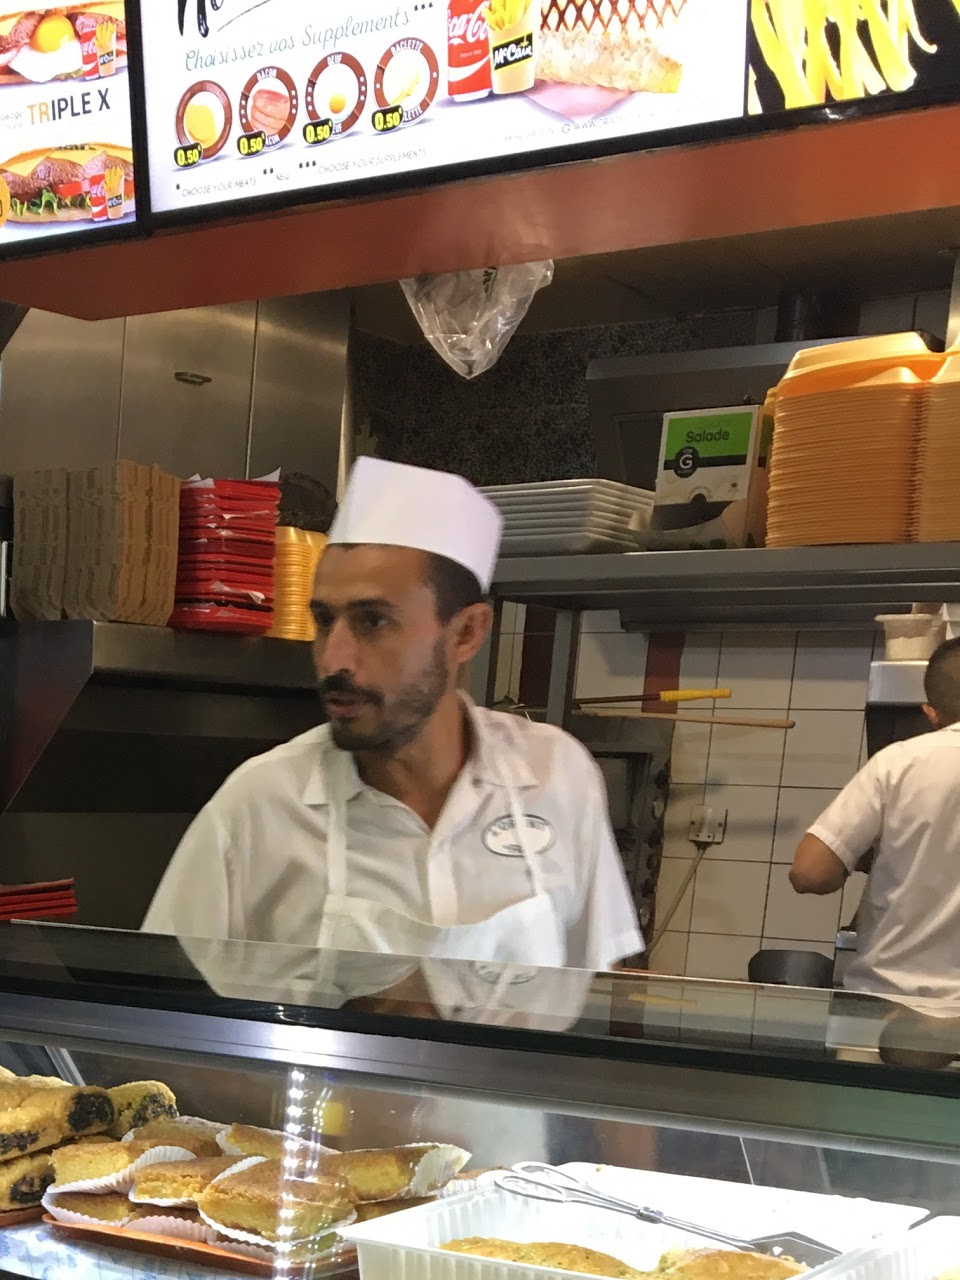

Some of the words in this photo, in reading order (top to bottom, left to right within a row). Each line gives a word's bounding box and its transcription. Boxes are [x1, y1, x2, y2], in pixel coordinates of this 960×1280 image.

[185, 41, 265, 72] Choisissez
[269, 36, 296, 55] vos
[390, 38, 424, 56] RACLETTE
[493, 42, 533, 67] McCain
[256, 68, 278, 82] BACON
[27, 91, 92, 125] TRIPLE
[98, 88, 111, 112] X
[685, 427, 731, 444] Salade
